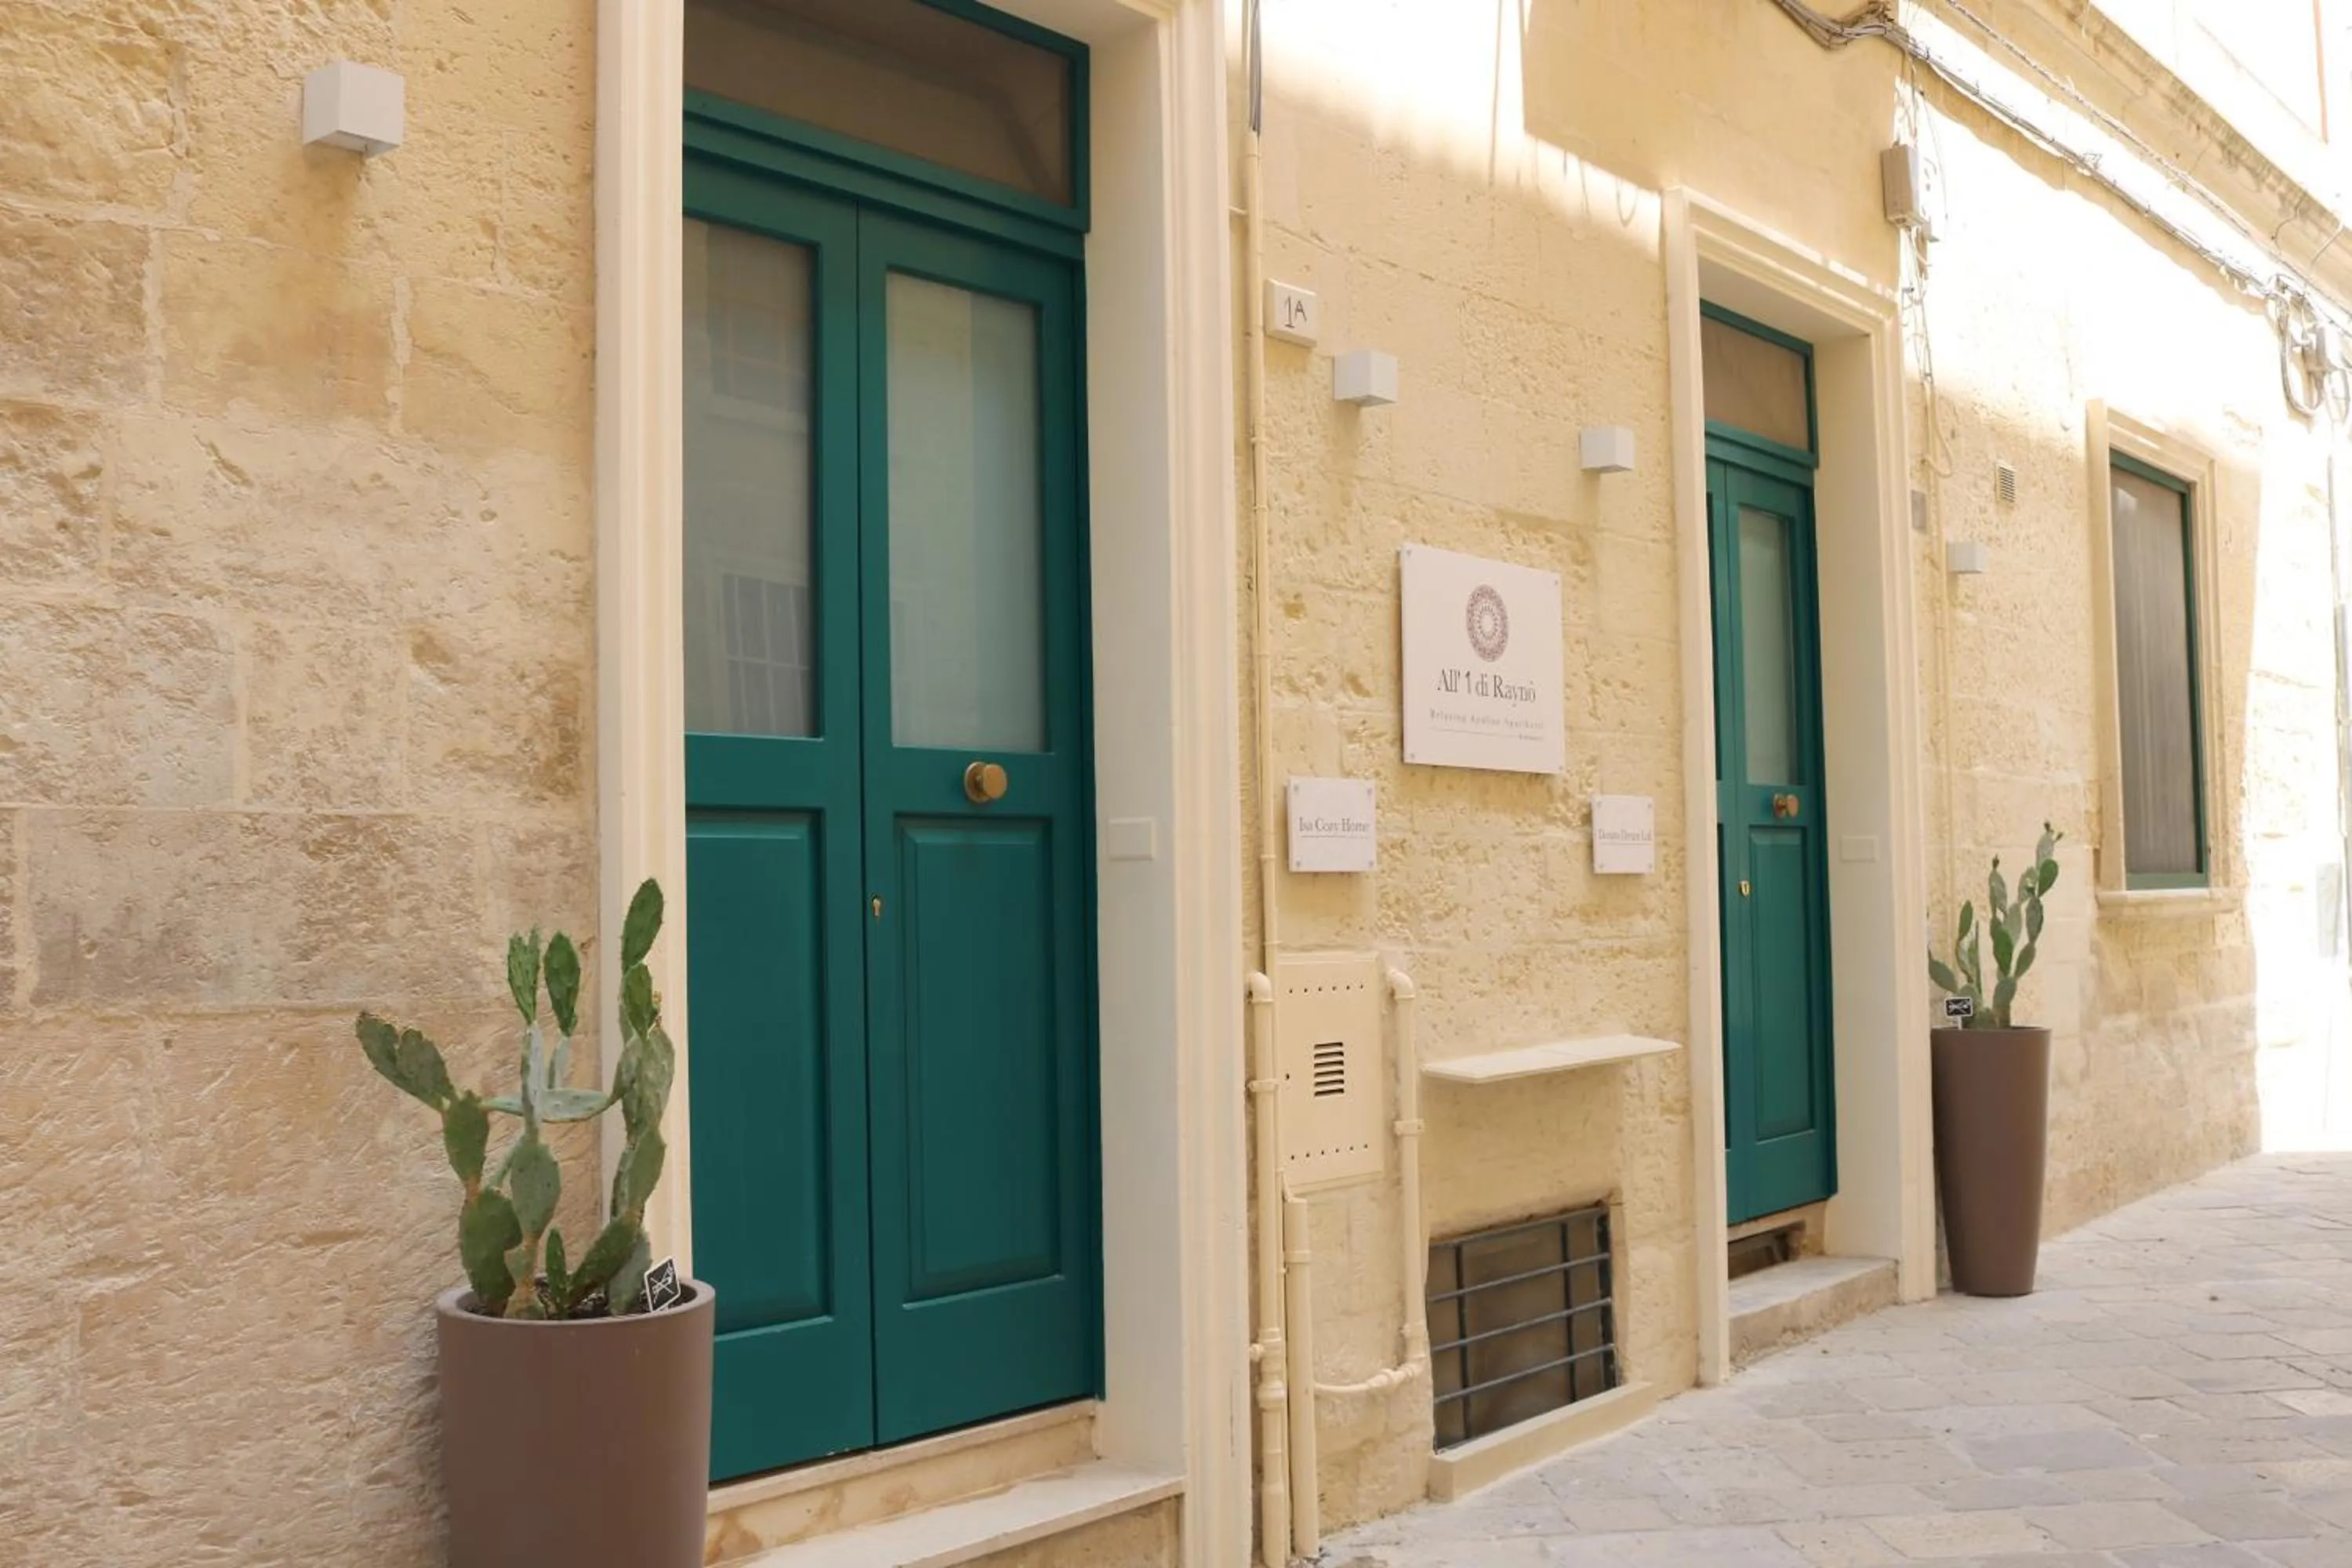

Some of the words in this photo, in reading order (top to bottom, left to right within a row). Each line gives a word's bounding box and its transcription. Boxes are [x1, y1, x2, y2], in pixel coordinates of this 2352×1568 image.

[1284, 296, 1308, 328] 1A
[1437, 668, 1461, 692] All'
[1475, 673, 1490, 697] di
